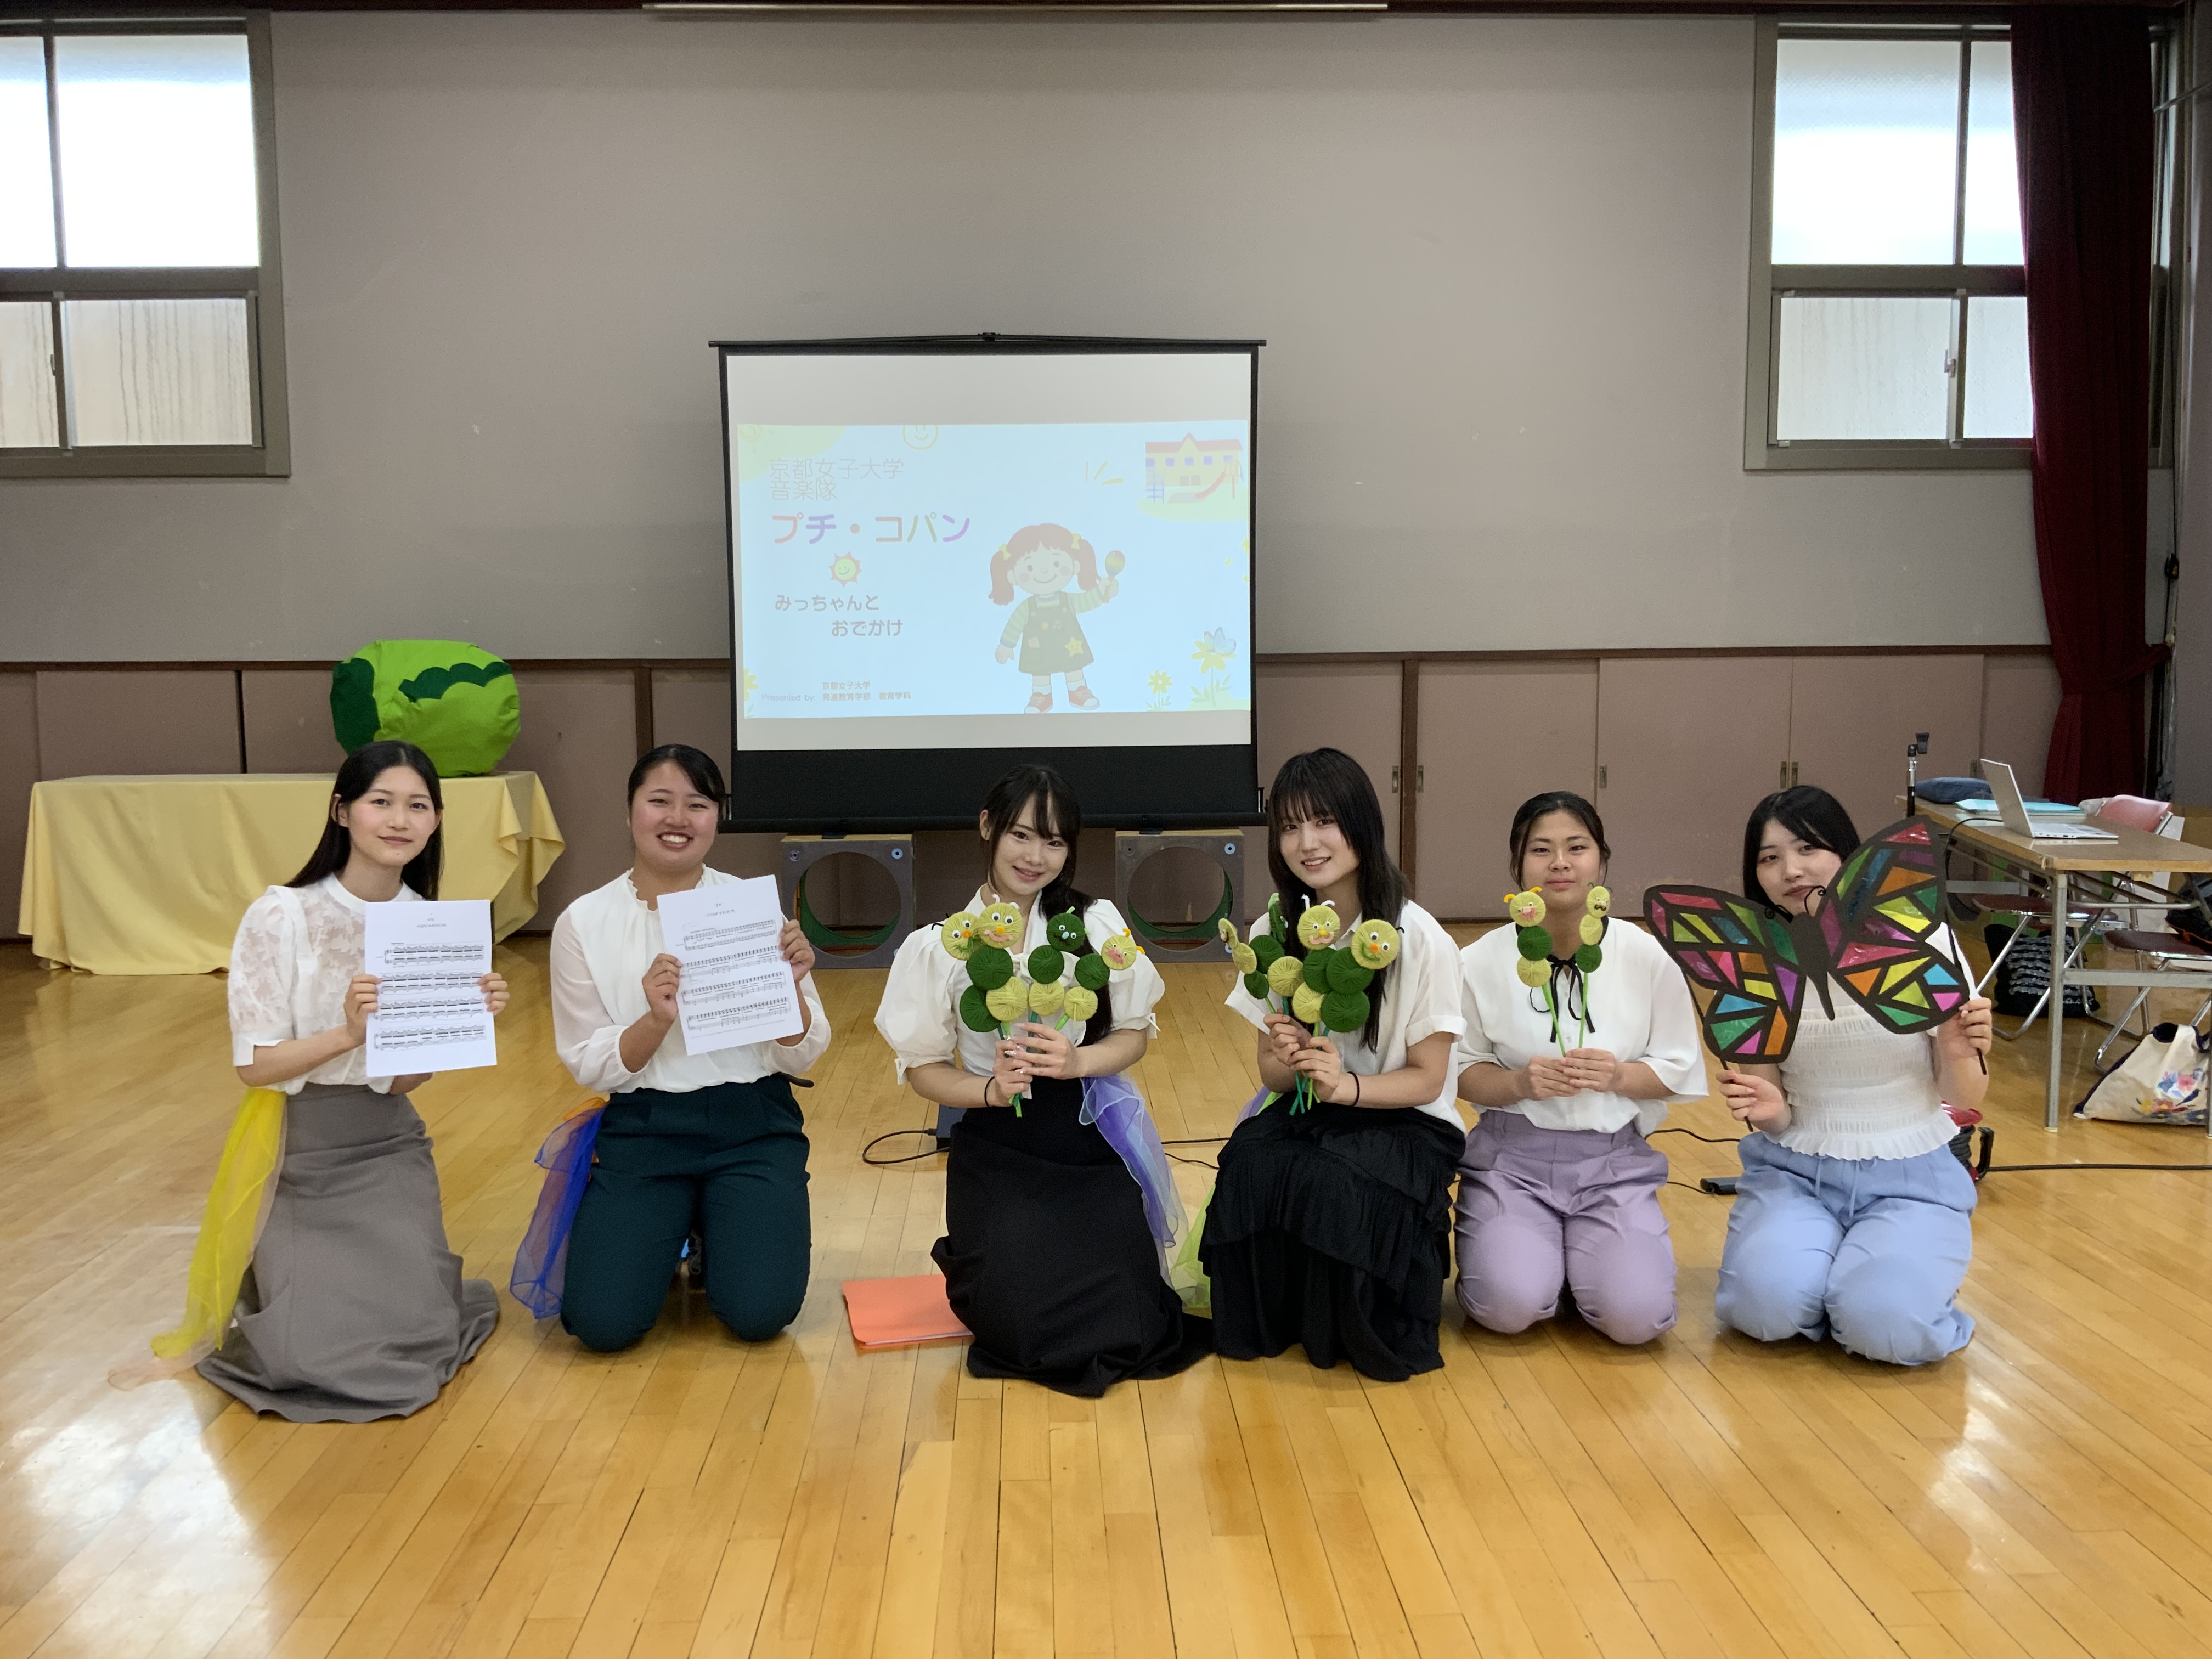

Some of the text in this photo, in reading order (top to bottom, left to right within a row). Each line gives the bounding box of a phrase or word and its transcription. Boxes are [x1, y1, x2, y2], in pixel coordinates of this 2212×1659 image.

[769, 457, 904, 480] 京都女子大学
[769, 479, 837, 501] 音楽隊
[772, 511, 970, 544] プチ・コパン
[774, 594, 879, 612] みっちゃんと
[831, 619, 904, 637] おでかけ
[761, 693, 816, 703] Presented by:
